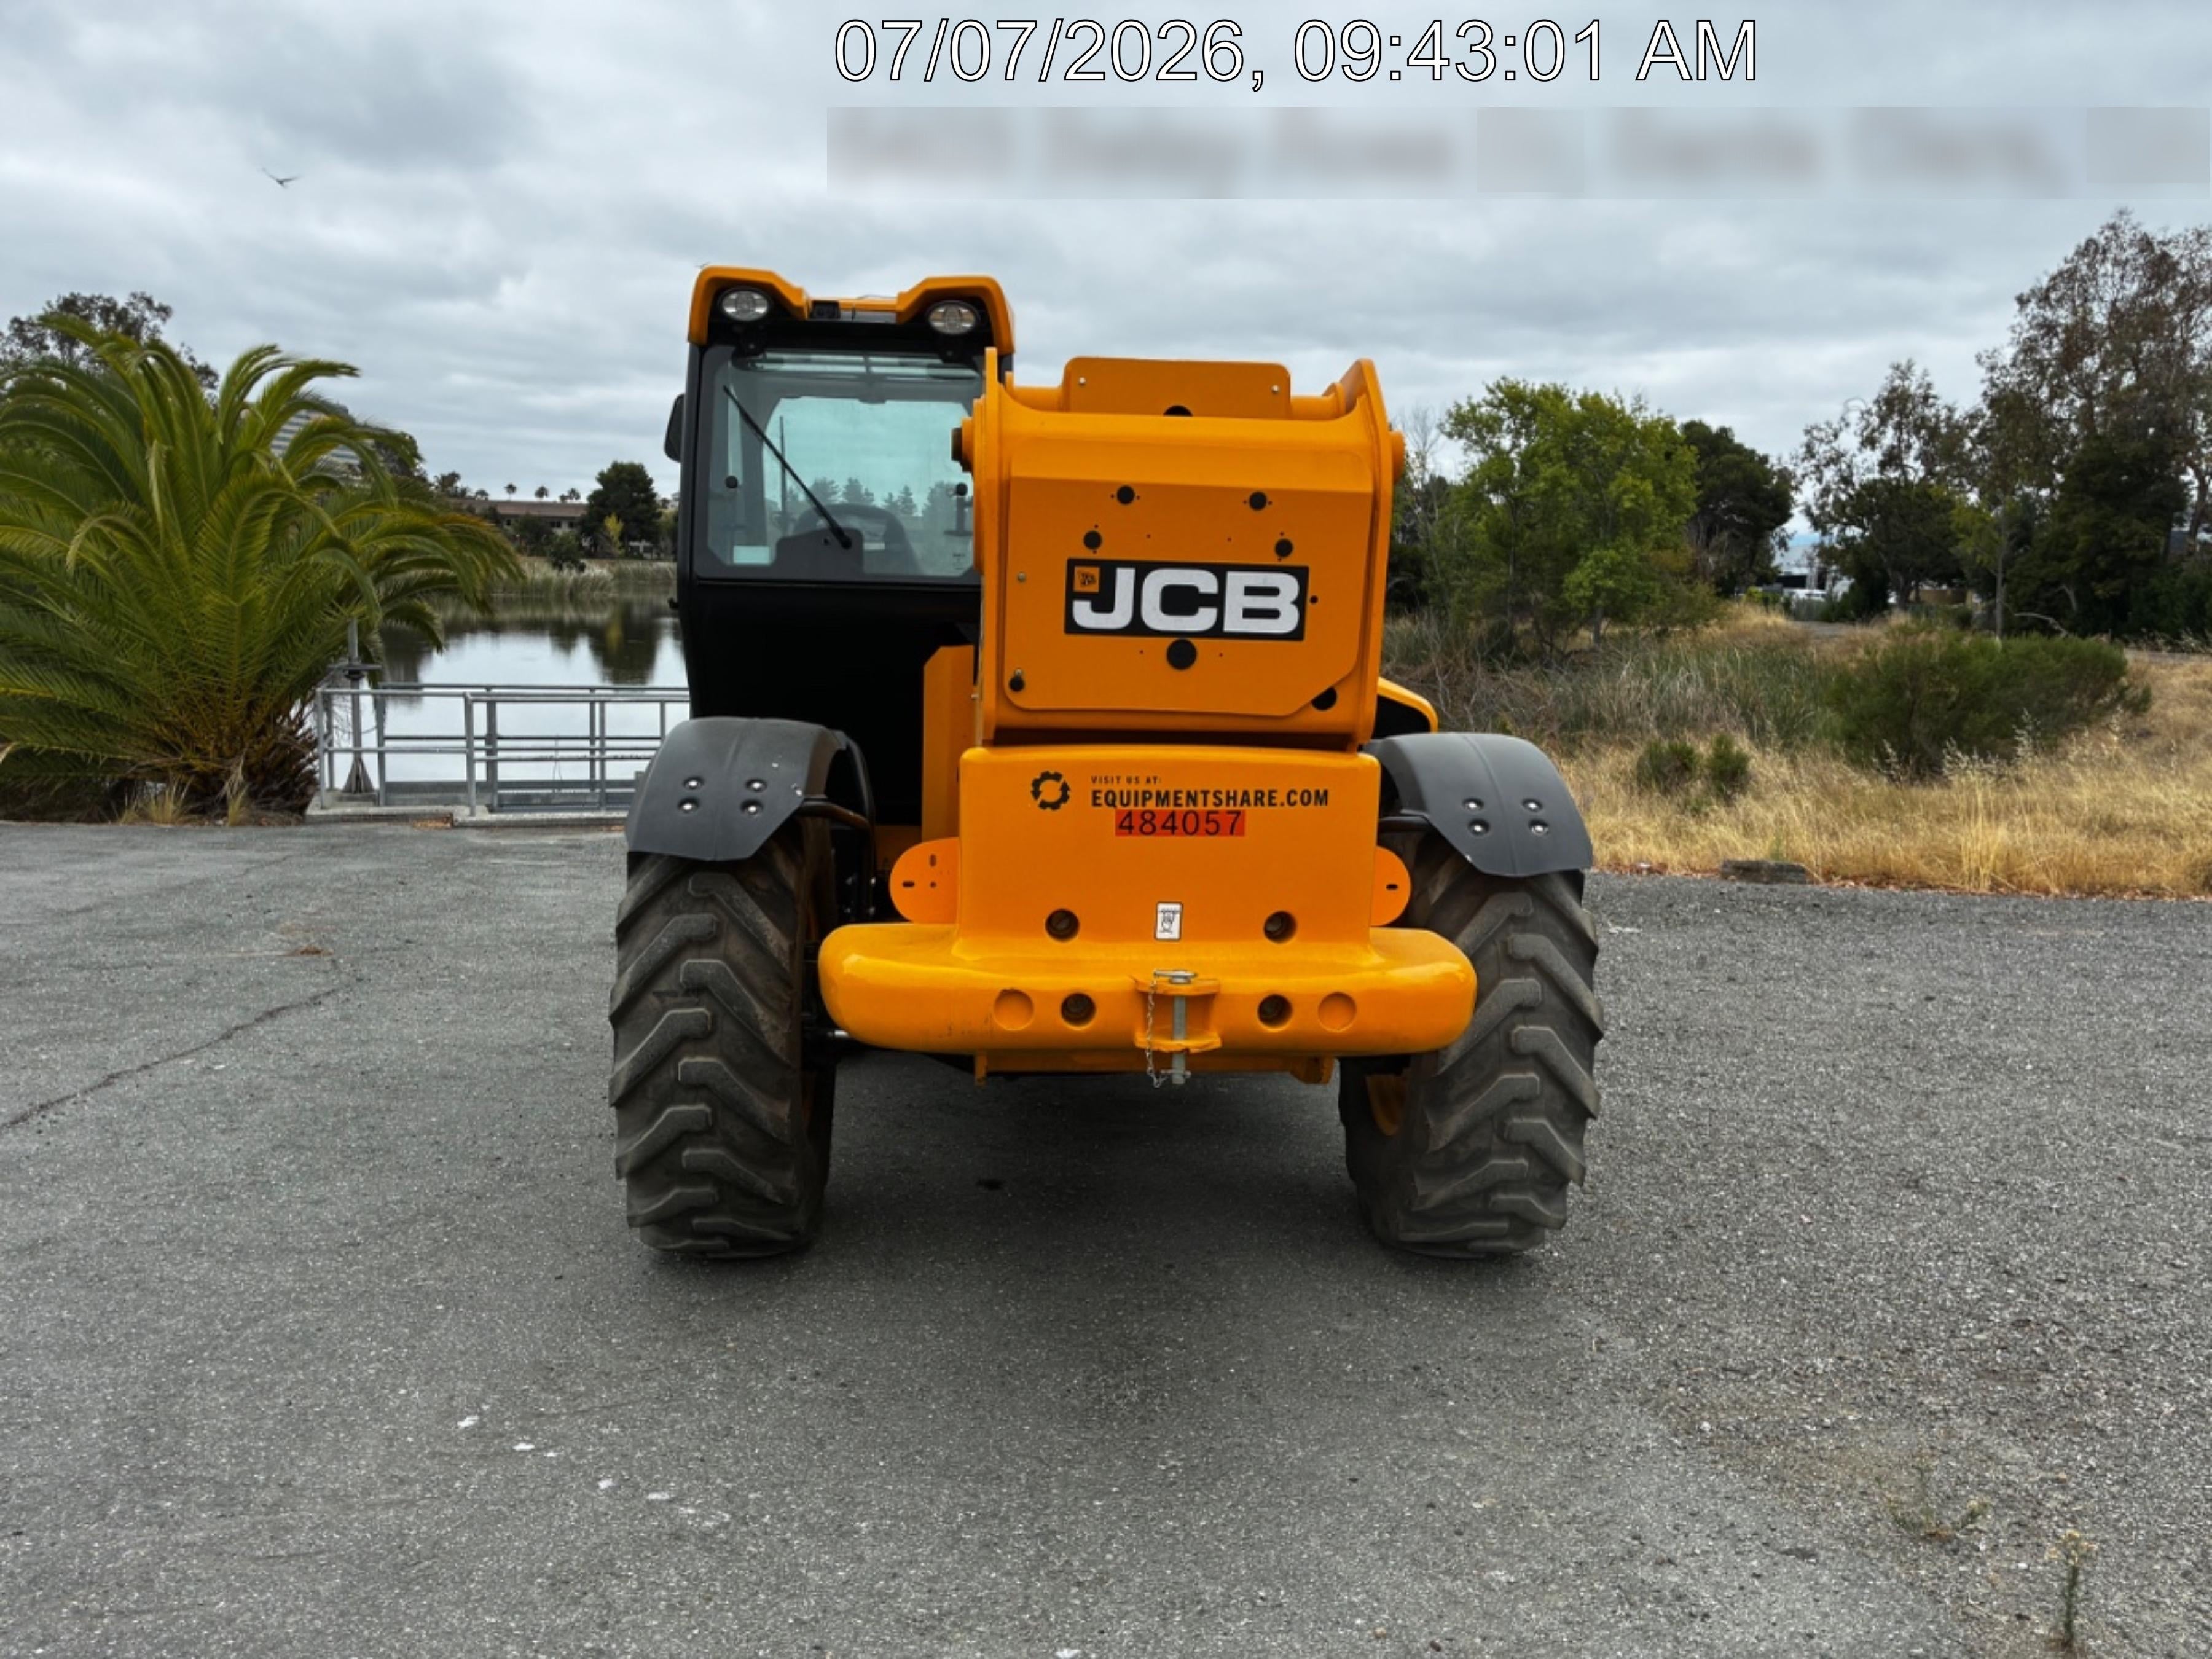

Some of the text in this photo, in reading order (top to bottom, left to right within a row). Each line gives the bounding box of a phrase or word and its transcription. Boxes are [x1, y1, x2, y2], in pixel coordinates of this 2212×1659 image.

[1072, 567, 1300, 635] JCB
[1091, 775, 1121, 785] VISIT
[1126, 775, 1140, 785] US
[1091, 789, 1329, 809] EQUIPMENTSHARE.COM
[1118, 809, 1242, 836] 484057
